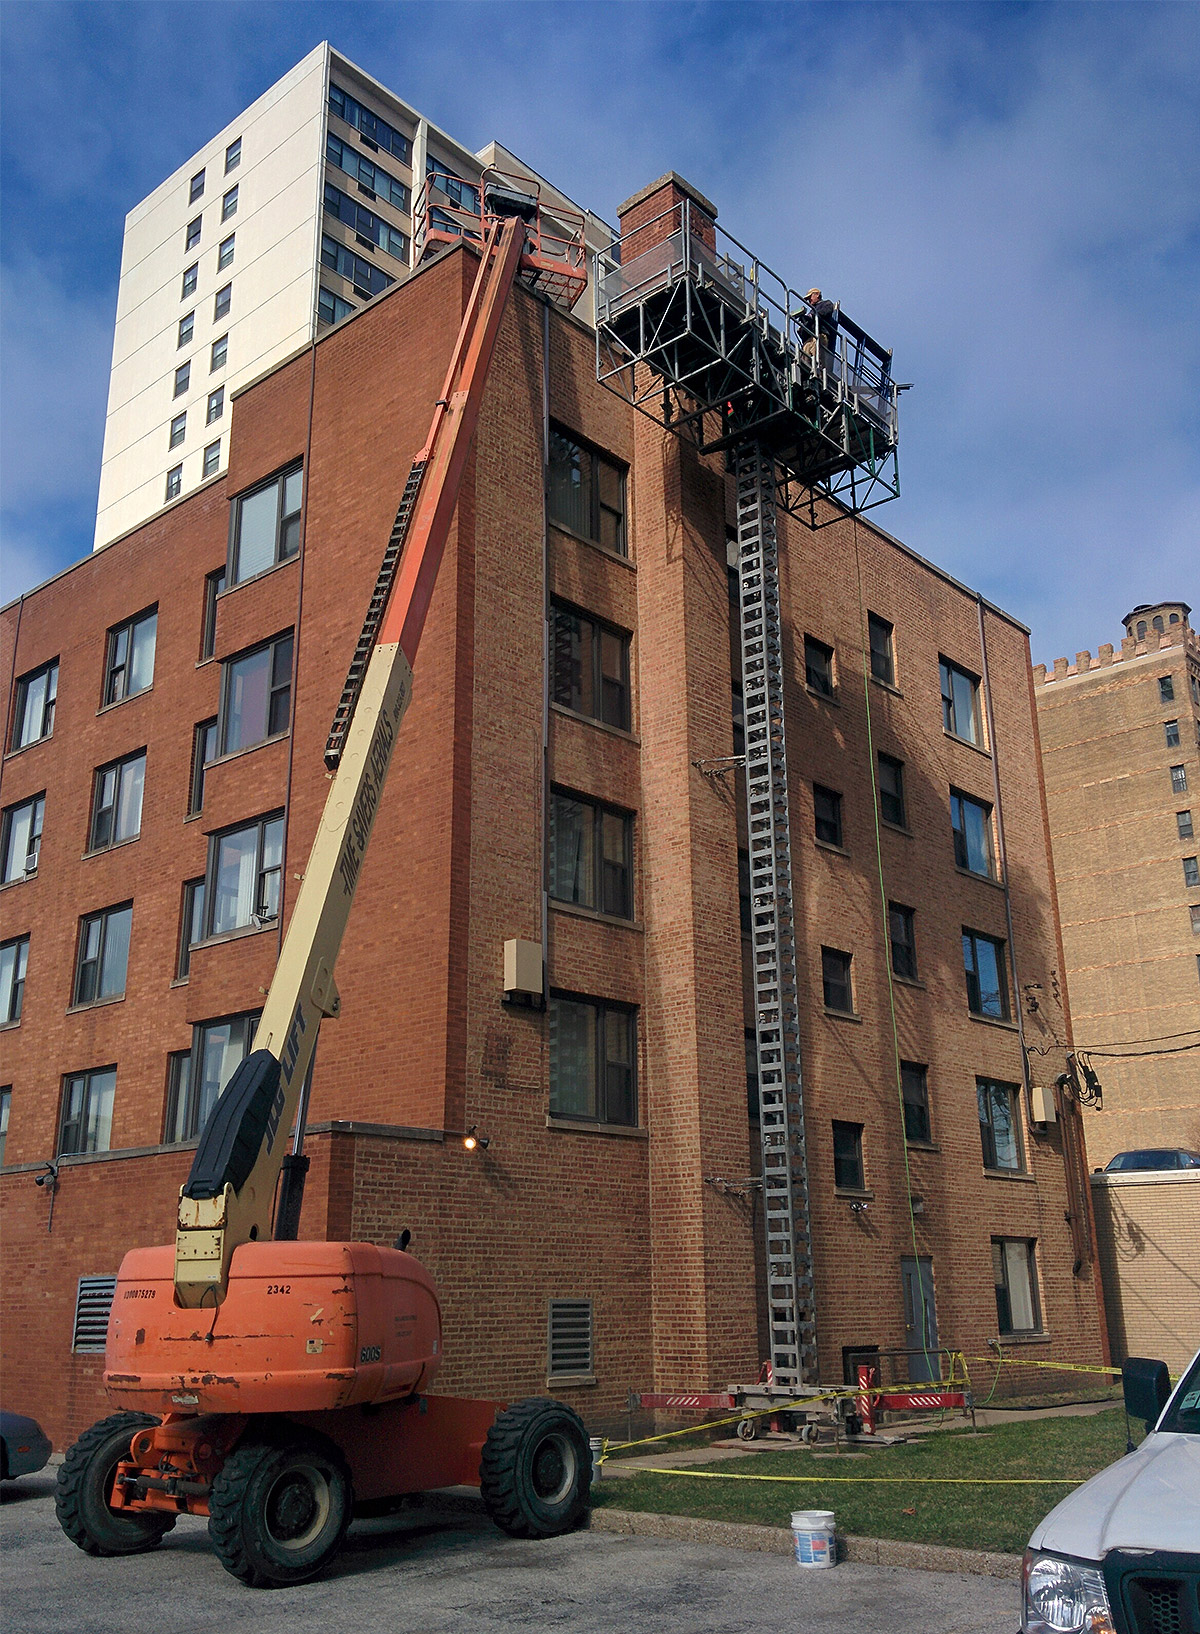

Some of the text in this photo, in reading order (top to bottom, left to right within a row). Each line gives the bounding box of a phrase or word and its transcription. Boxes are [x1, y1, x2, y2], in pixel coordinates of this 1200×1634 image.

[340, 709, 393, 896] TIME SAVERS AERIALS
[265, 1001, 306, 1156] JLG LIFT
[267, 1284, 291, 1295] 2342
[360, 1345, 381, 1364] 600S
